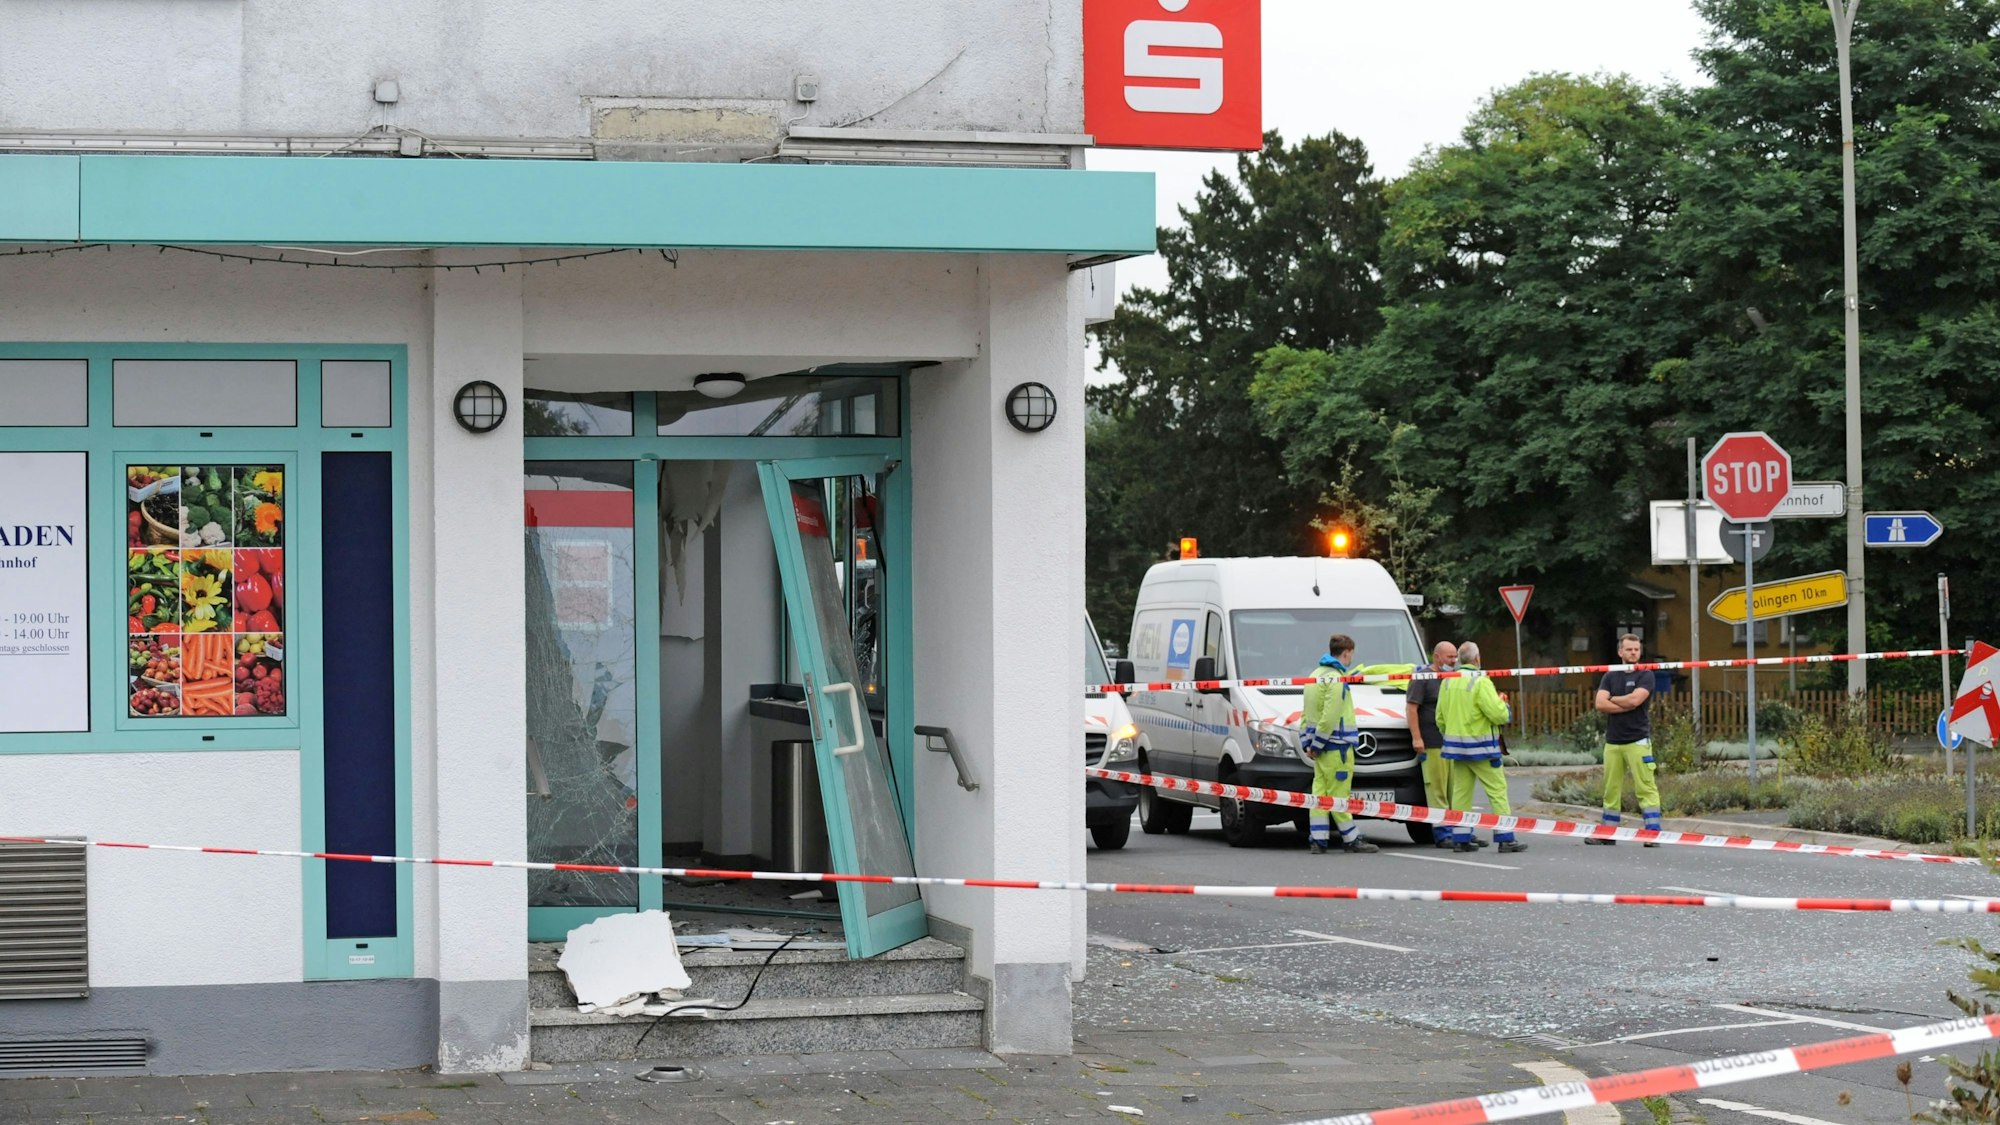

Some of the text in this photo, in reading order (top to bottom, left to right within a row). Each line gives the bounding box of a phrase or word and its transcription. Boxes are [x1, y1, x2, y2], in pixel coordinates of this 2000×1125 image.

[1713, 460, 1780, 495] STOP
[1801, 587, 1812, 600] 10
[1814, 588, 1828, 599] km
[14, 613, 44, 624] 19.00
[48, 613, 70, 624] Uhr
[14, 629, 44, 639] 14.00
[48, 629, 70, 639] Uhr
[22, 644, 70, 653] geschlossen
[1366, 792, 1377, 801] XX
[1379, 791, 1394, 801] 717
